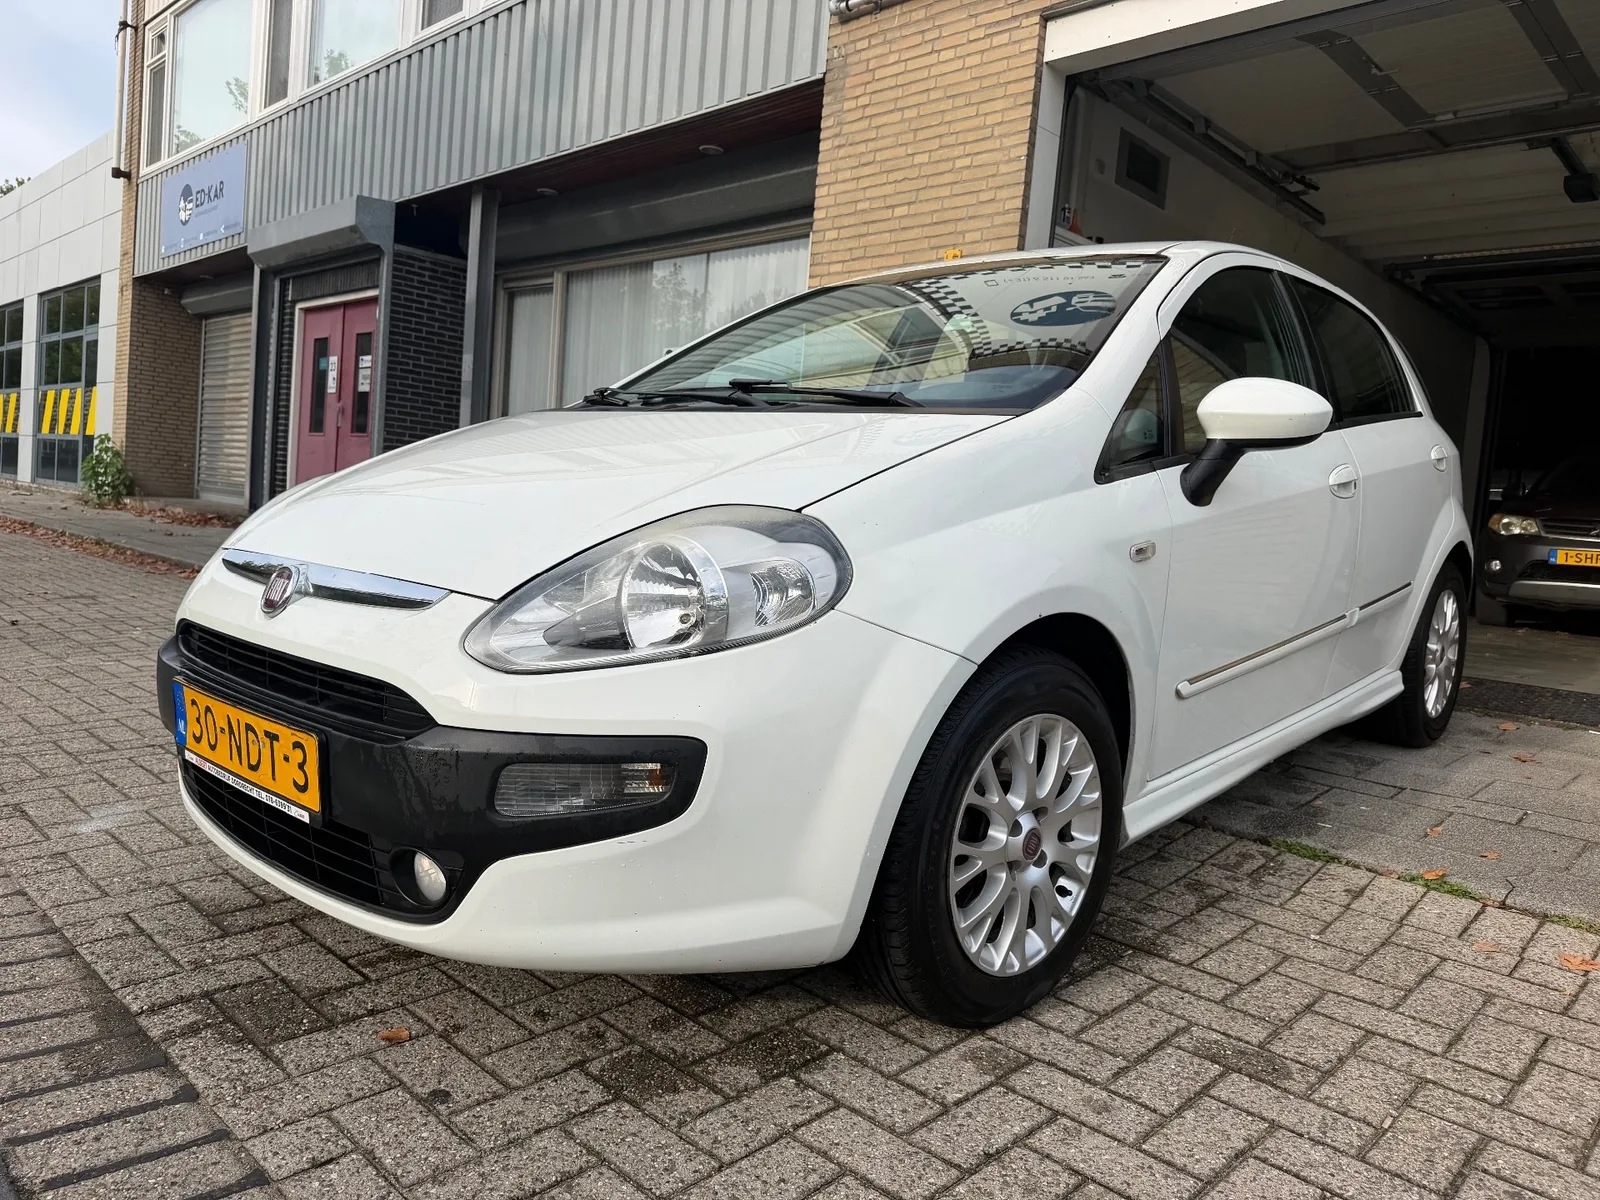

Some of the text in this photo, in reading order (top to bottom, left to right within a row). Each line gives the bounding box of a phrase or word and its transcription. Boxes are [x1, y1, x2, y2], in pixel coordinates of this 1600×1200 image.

[266, 577, 289, 602] FIAT
[178, 718, 186, 735] NL
[190, 698, 309, 794] 30-NDT-3
